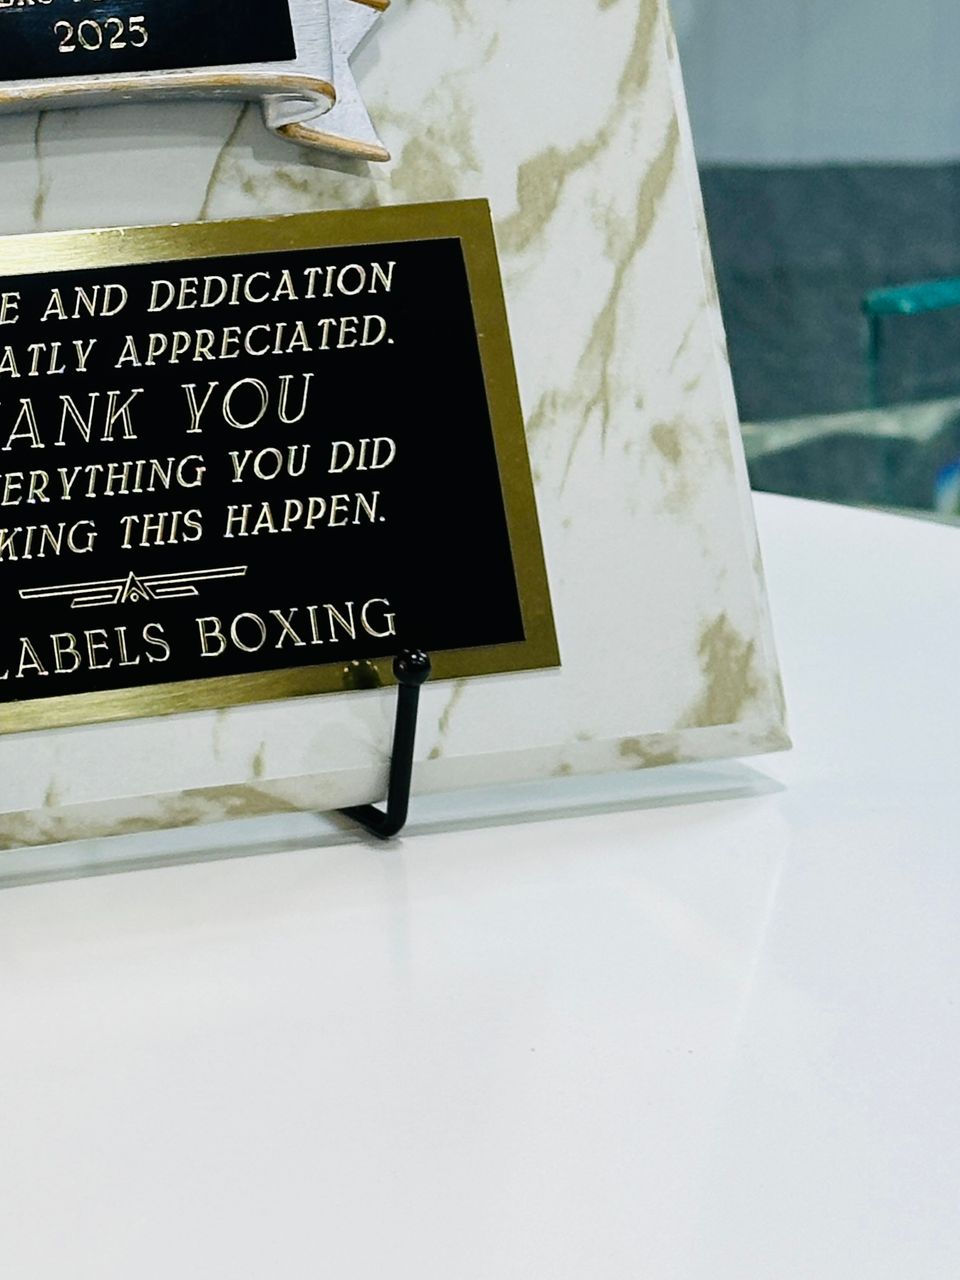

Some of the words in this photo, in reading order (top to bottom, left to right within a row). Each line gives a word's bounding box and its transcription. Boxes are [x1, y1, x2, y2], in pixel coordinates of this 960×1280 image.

[52, 15, 150, 53] 2025
[40, 284, 128, 321] AND
[147, 261, 397, 314] DEDICATION
[114, 314, 396, 369] APPRECIATED.
[181, 372, 315, 434] YOU
[228, 444, 311, 484] YOU
[328, 436, 397, 475] DID
[120, 509, 204, 549] THIS
[224, 491, 387, 538] HAPPEN.
[195, 598, 397, 658] BOXING
